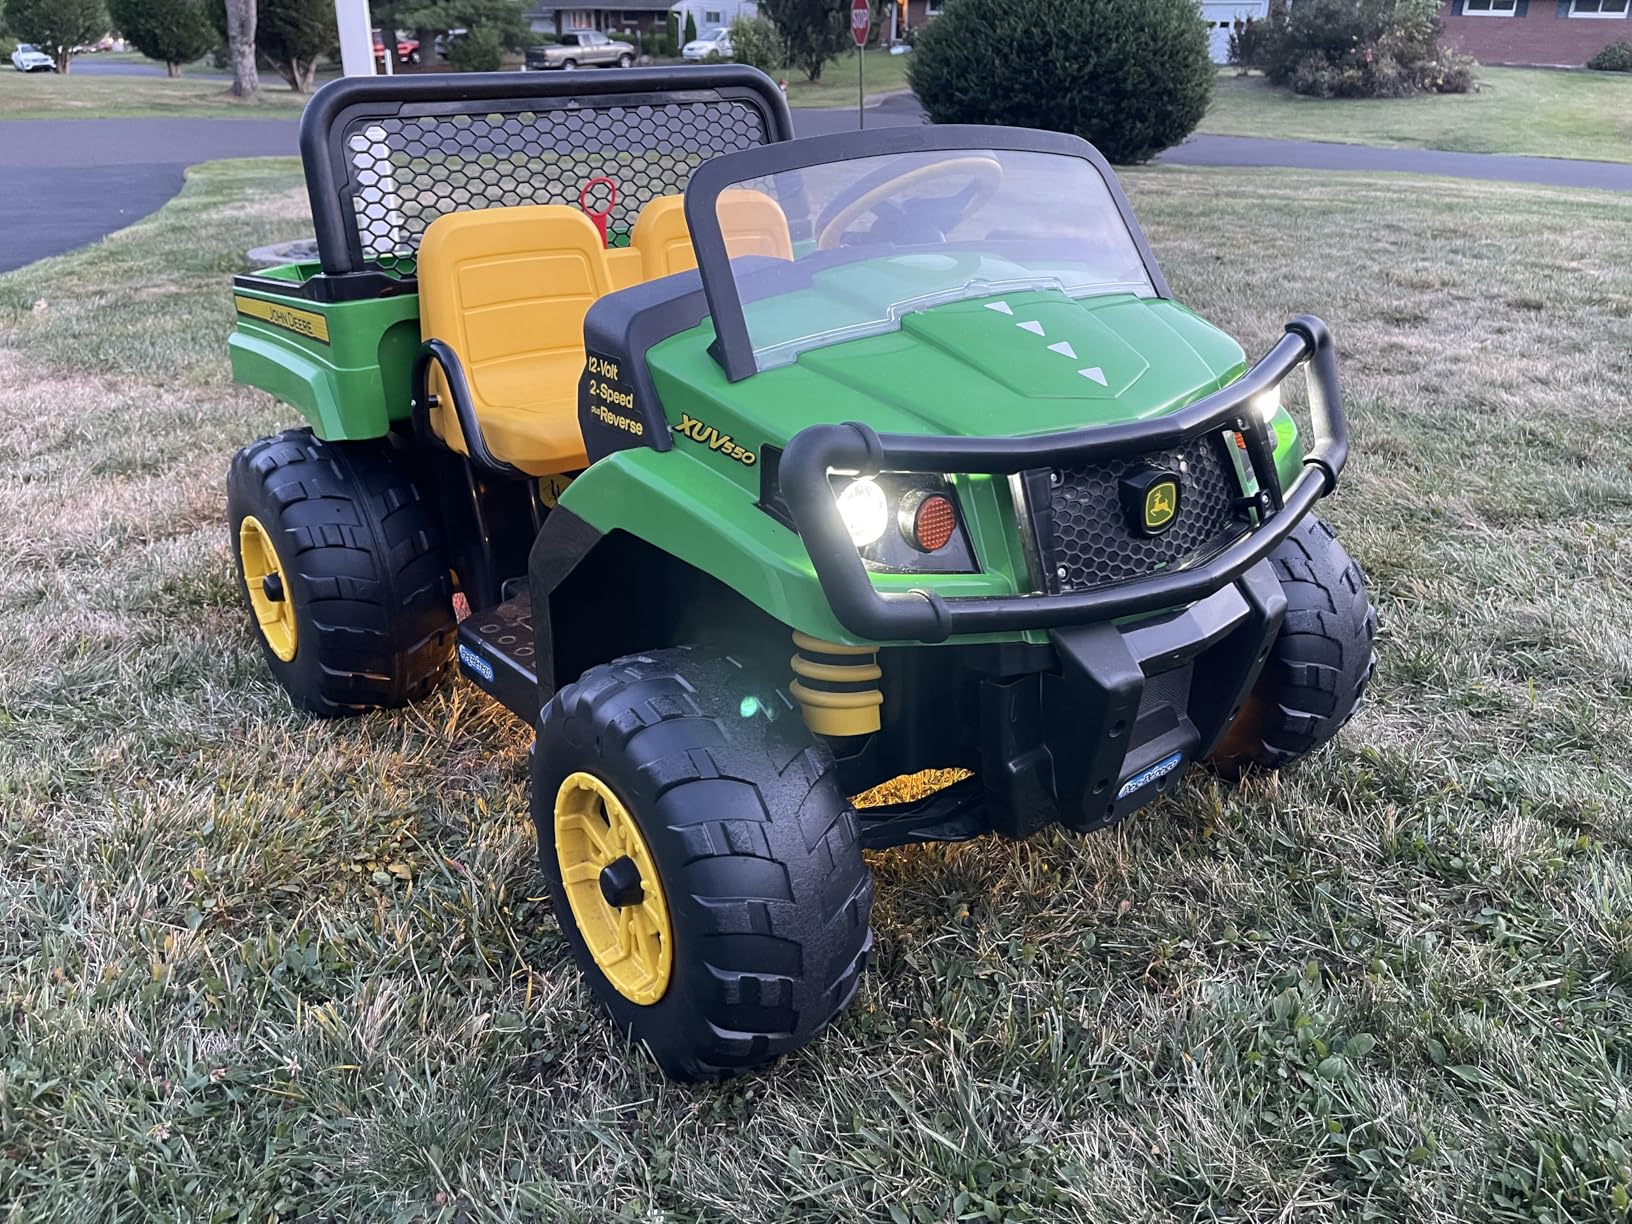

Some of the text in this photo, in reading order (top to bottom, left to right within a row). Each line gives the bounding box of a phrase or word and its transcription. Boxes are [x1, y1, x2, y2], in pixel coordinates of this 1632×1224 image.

[852, 9, 868, 29] STOP
[269, 306, 313, 335] JOHN DEERE
[588, 356, 618, 380] 12-Volt
[589, 380, 633, 408] 2-Speed
[600, 406, 643, 435] Reverse
[675, 413, 757, 465] XUV550
